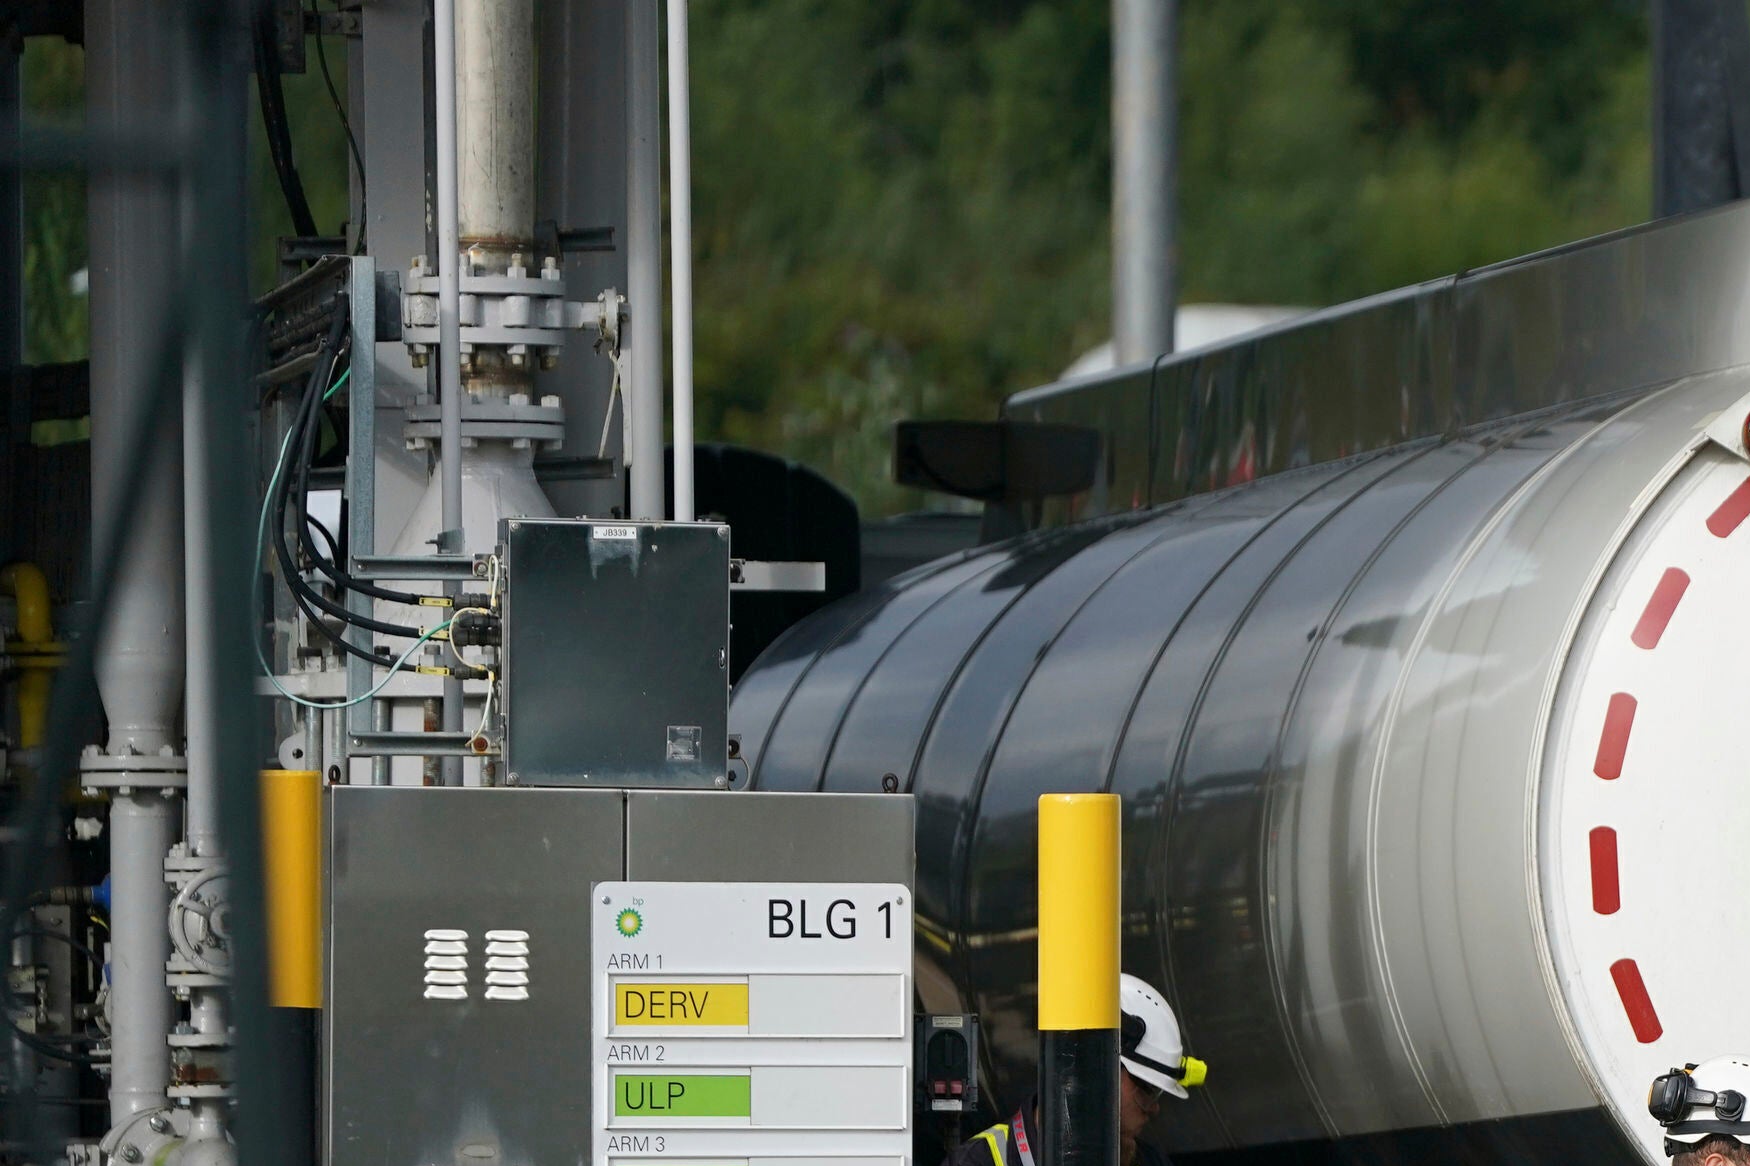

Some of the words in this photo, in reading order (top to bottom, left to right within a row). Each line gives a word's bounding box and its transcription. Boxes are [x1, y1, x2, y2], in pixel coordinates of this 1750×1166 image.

[602, 528, 628, 537] JB339
[632, 896, 645, 906] bp
[768, 898, 856, 940] BLG
[877, 901, 892, 939] 1
[607, 954, 649, 969] ARM
[656, 954, 664, 969] 1
[625, 990, 709, 1019] DERV
[607, 1045, 649, 1061] ARM
[655, 1045, 665, 1061] 2
[625, 1081, 685, 1110] ULP
[607, 1136, 649, 1152] ARM
[655, 1136, 665, 1152] 3
